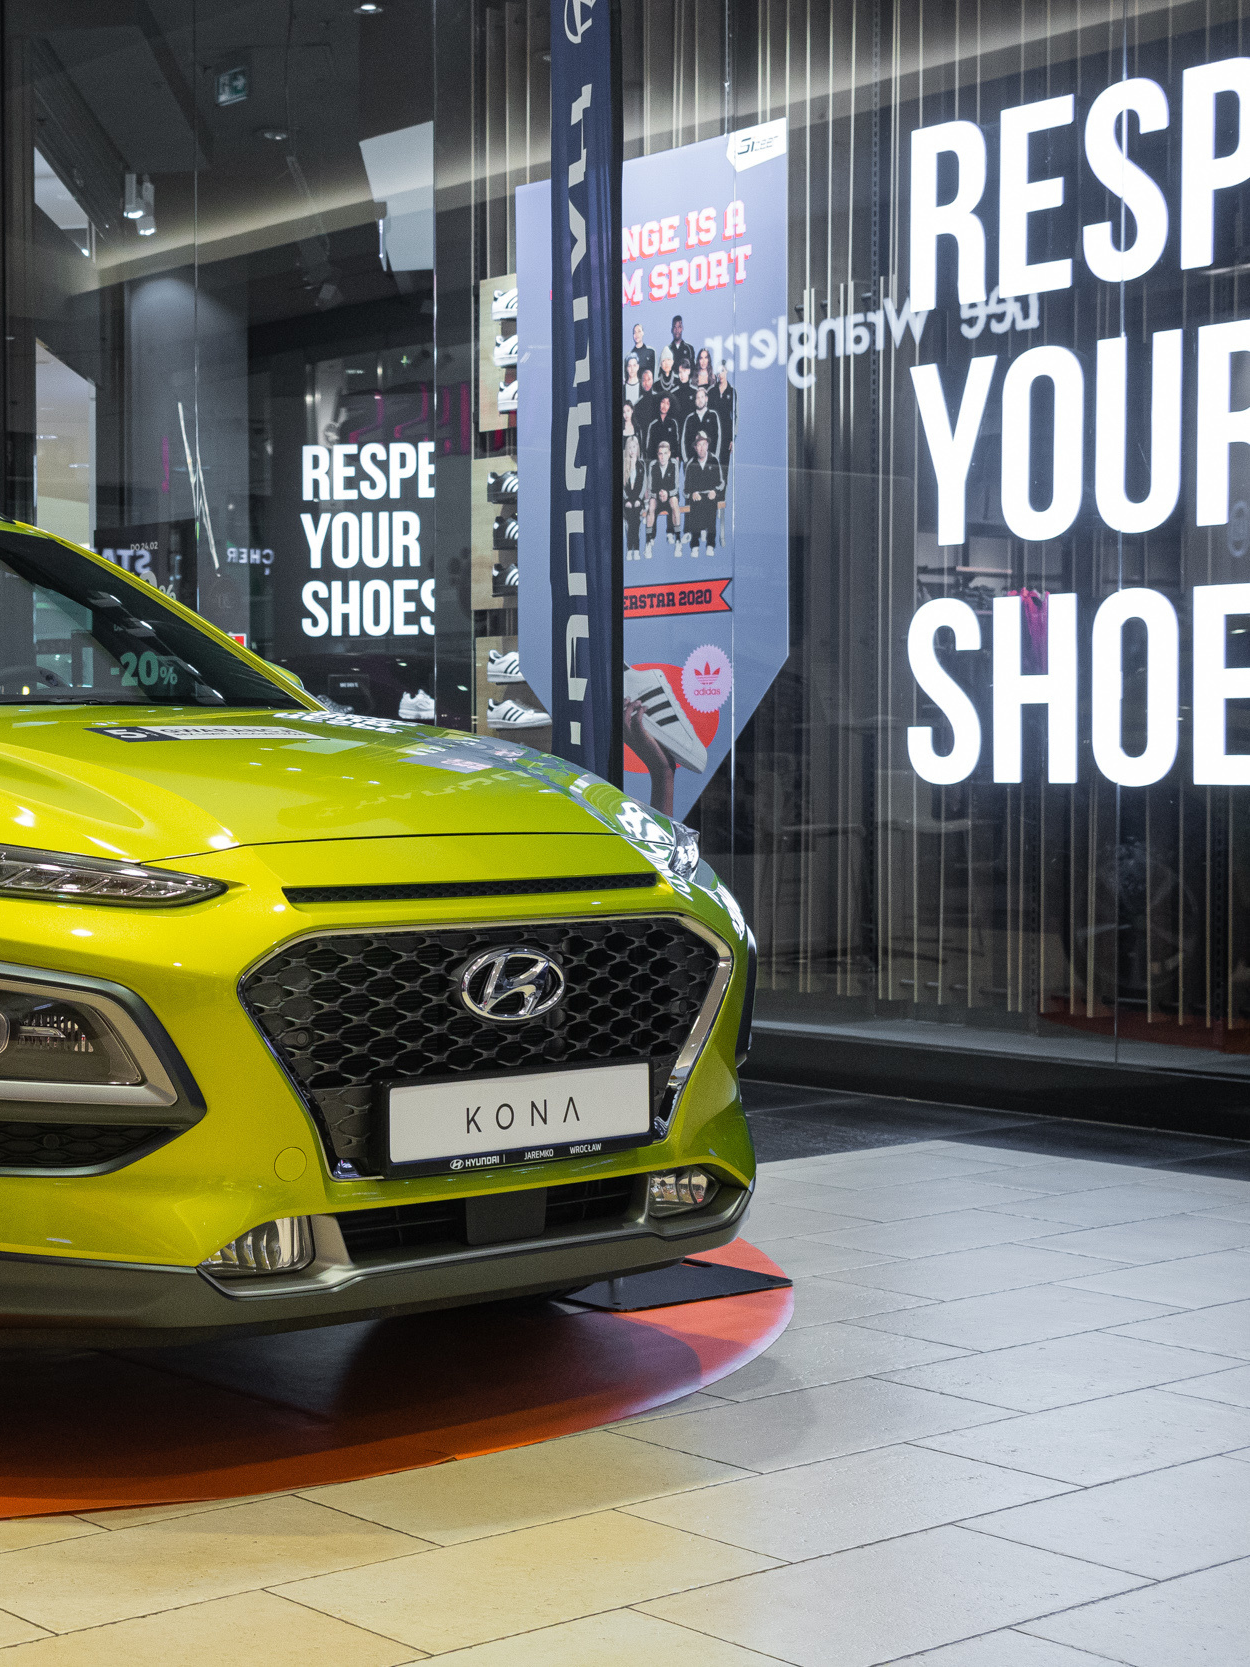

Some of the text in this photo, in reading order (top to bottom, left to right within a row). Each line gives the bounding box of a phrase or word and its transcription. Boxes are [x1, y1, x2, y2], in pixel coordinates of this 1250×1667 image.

[685, 207, 717, 250] IS
[722, 200, 746, 241] A
[649, 244, 752, 302] SPORT
[302, 441, 436, 501] RESPE
[300, 511, 421, 569] YOUR
[679, 589, 712, 605] 2020
[110, 651, 178, 687] -20%
[694, 687, 721, 696] adidas
[466, 1097, 580, 1134] KONA
[465, 1143, 602, 1167] HYUNDAI JAREMKO WROCŁAW
